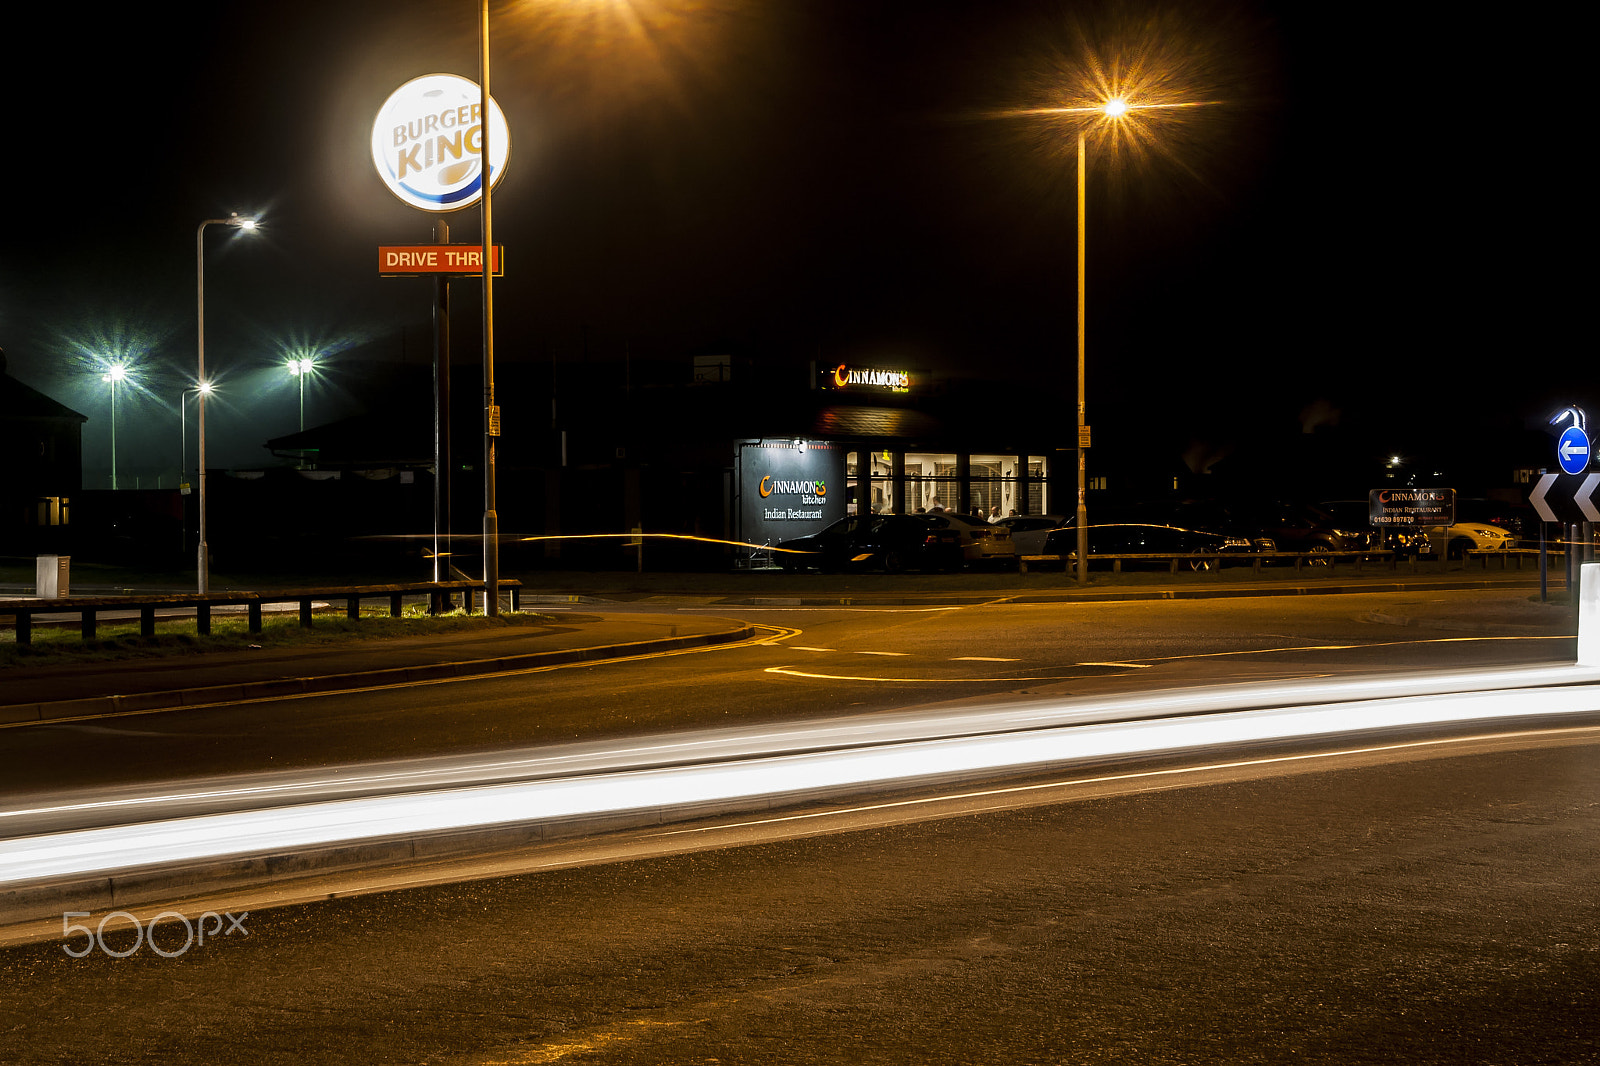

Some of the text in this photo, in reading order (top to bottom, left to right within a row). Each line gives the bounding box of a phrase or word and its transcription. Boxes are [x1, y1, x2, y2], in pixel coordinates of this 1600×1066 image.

[393, 103, 482, 148] BURGER
[398, 124, 482, 180] KING
[386, 251, 483, 266] DRIVE THR
[835, 364, 901, 387] CINNAMON
[760, 475, 816, 498] CINNAMON
[802, 494, 826, 505] kitchen
[1379, 490, 1436, 504] CINNAMON
[764, 508, 822, 519] Indian Restaurant
[1382, 506, 1442, 514] INDIAN RESTAURANT
